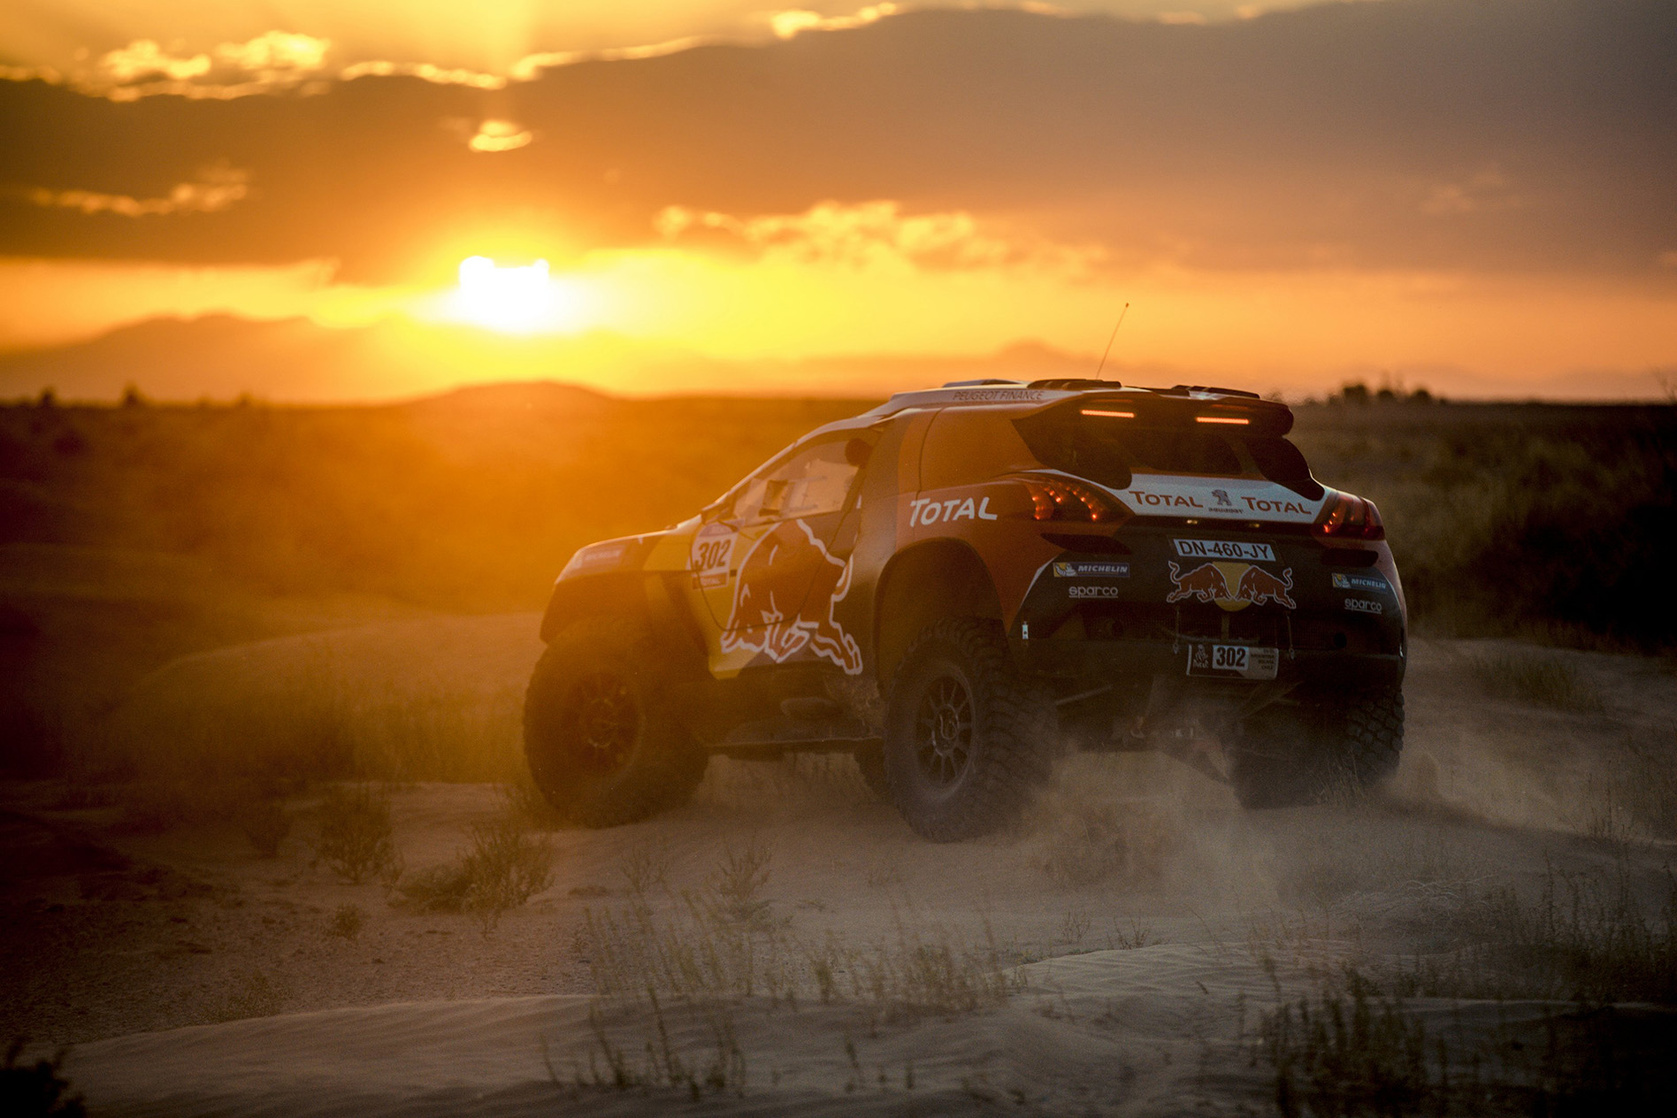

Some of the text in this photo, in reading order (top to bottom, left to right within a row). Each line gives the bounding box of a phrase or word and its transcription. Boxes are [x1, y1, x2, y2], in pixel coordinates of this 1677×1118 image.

[953, 390, 1044, 400] PEUGEOT FINANCE
[1128, 490, 1203, 509] TOTAL
[1241, 496, 1312, 515] TOTAL
[909, 496, 998, 528] TOTAL
[694, 539, 731, 572] 302
[1178, 541, 1269, 559] DN-460-JY
[1078, 565, 1128, 573] MICHELIN
[1068, 586, 1119, 598] sparco
[1351, 578, 1387, 589] MICHELIN
[1344, 598, 1383, 614] sparco
[1216, 646, 1246, 667] 302
